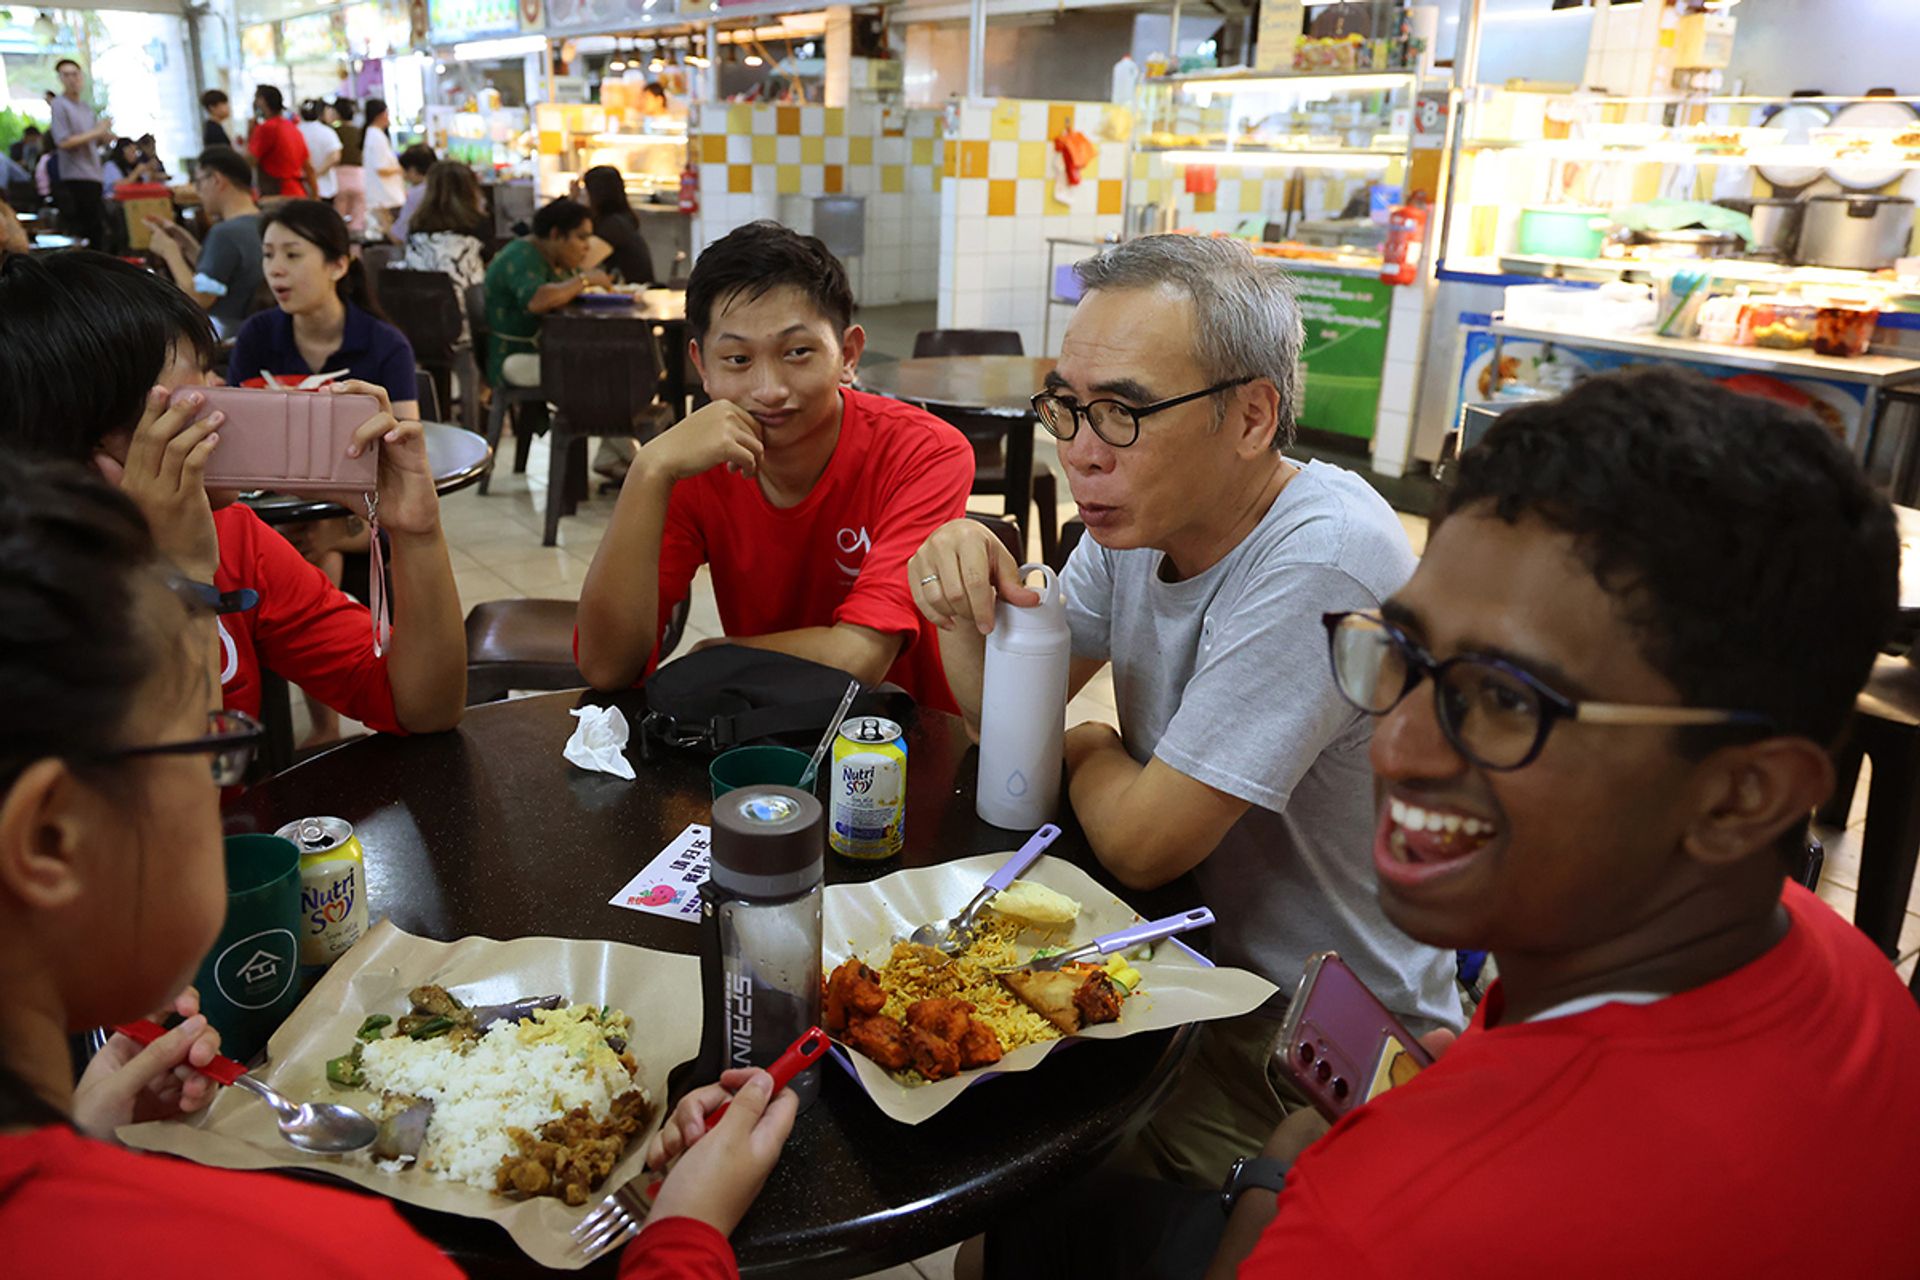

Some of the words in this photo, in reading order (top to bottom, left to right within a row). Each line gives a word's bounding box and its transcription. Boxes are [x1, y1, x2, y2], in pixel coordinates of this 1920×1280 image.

[1422, 101, 1437, 127] 8
[843, 765, 875, 781] Nutri
[301, 867, 355, 914] Nutri
[733, 974, 752, 1068] SPRIN
